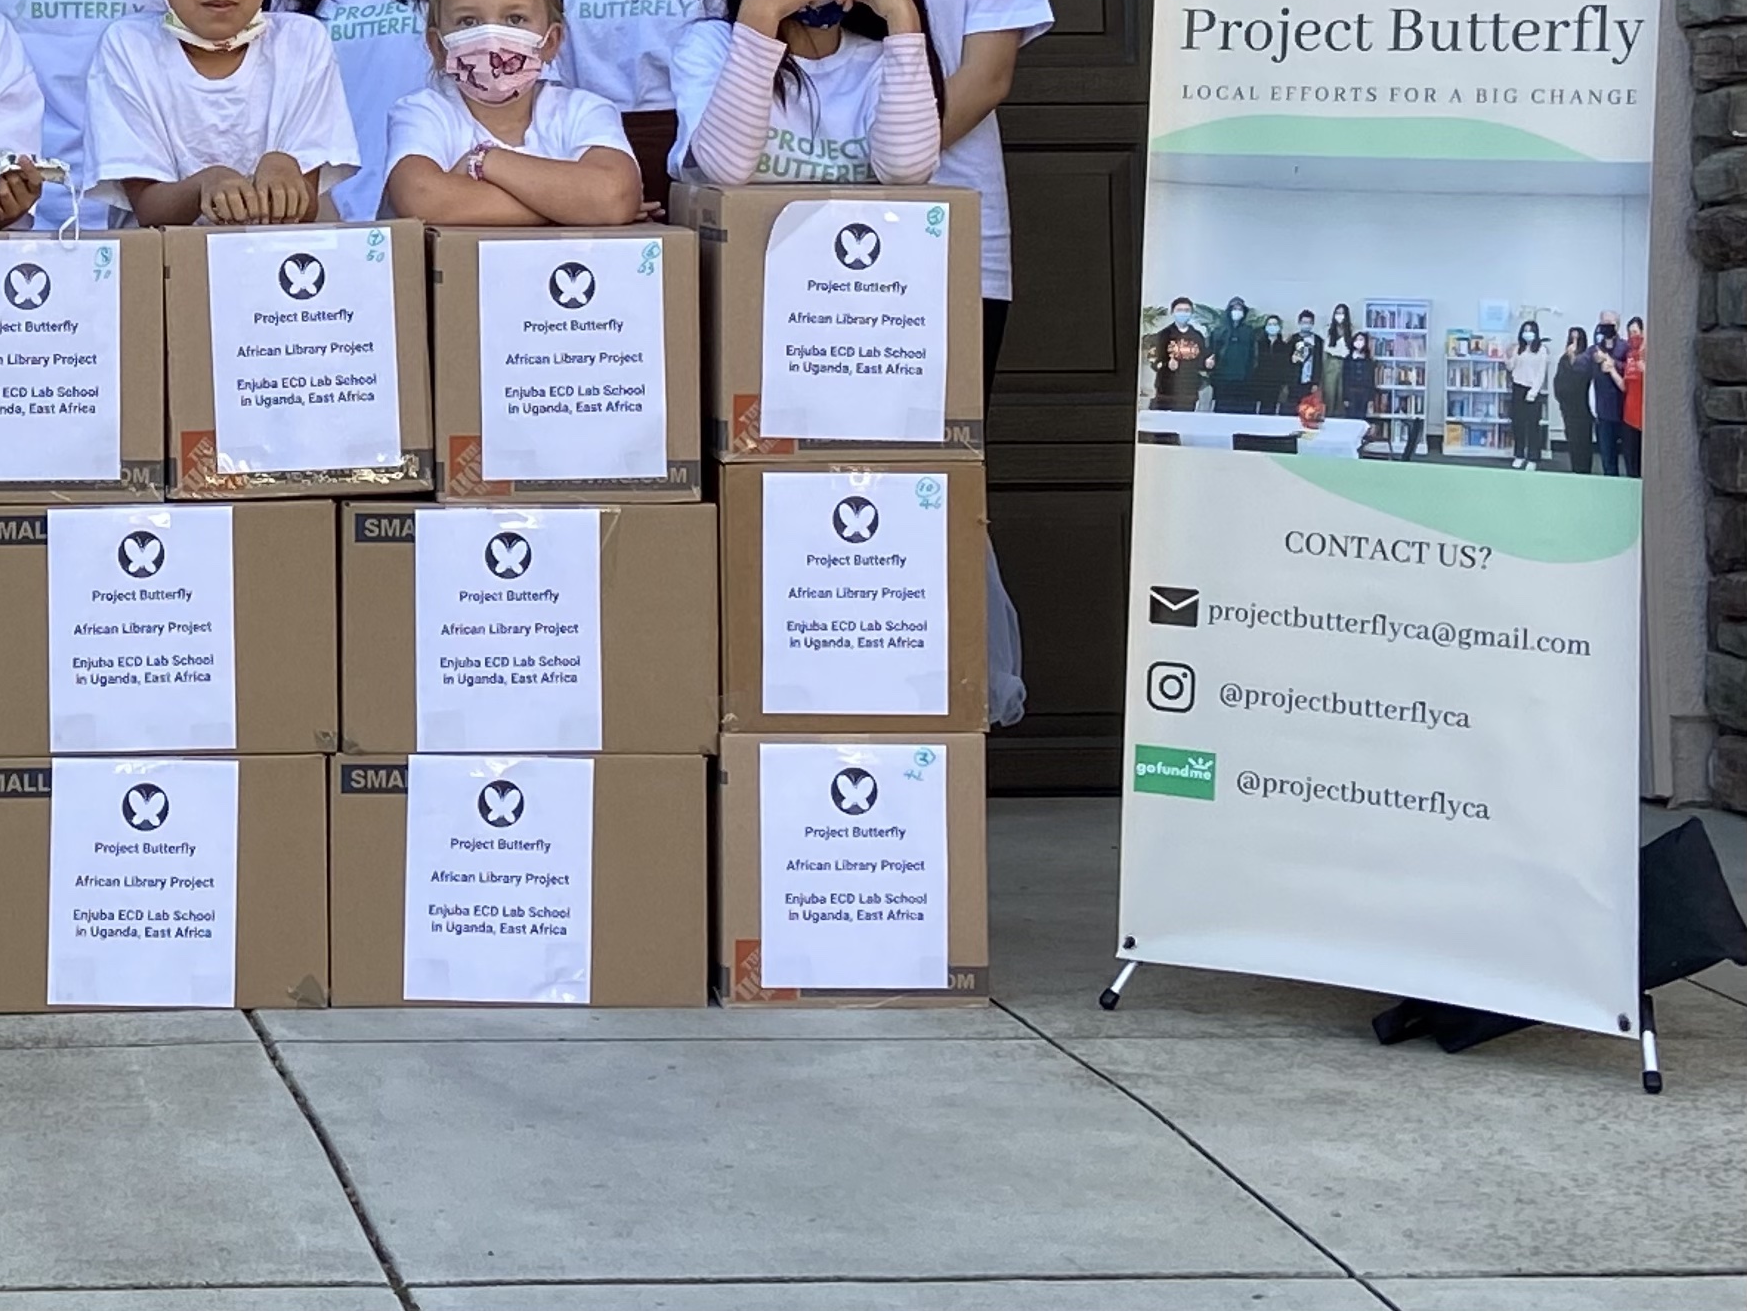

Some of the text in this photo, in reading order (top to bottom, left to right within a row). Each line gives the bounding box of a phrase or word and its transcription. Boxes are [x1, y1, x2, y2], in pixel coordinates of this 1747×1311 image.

[331, 16, 423, 42] BUTTERFL
[1180, 4, 1645, 66] Project Butterfly
[1181, 84, 1638, 105] LOCAL EFFORTS FOR A BIG CHANGE
[524, 319, 623, 334] Project Butterfly
[506, 352, 643, 366] African Library Project
[505, 384, 645, 400] Enjuba ECD Lab School
[508, 400, 642, 416] in Uganda, East Africa
[364, 518, 416, 538] SMA
[1284, 530, 1492, 571] CONTACT US?
[807, 554, 906, 568] Project Butterfly
[788, 587, 925, 601] African Library Project
[787, 620, 927, 634] Enjuba ECD Lab School
[1207, 601, 1591, 657] projectbutterflyca@gmail.com
[790, 636, 924, 651] in Uganda, East Africa
[1218, 681, 1471, 729] @projectbutterflyca
[350, 769, 407, 789] SMA
[1136, 761, 1212, 781] gofundme
[1236, 769, 1490, 821] @projectbutterflyca
[95, 842, 196, 857] Project Butterfly
[75, 875, 214, 890] African Library Project
[73, 909, 215, 923] Enjuba ECD Lab School
[76, 926, 212, 939] in Uganda, East Africa
